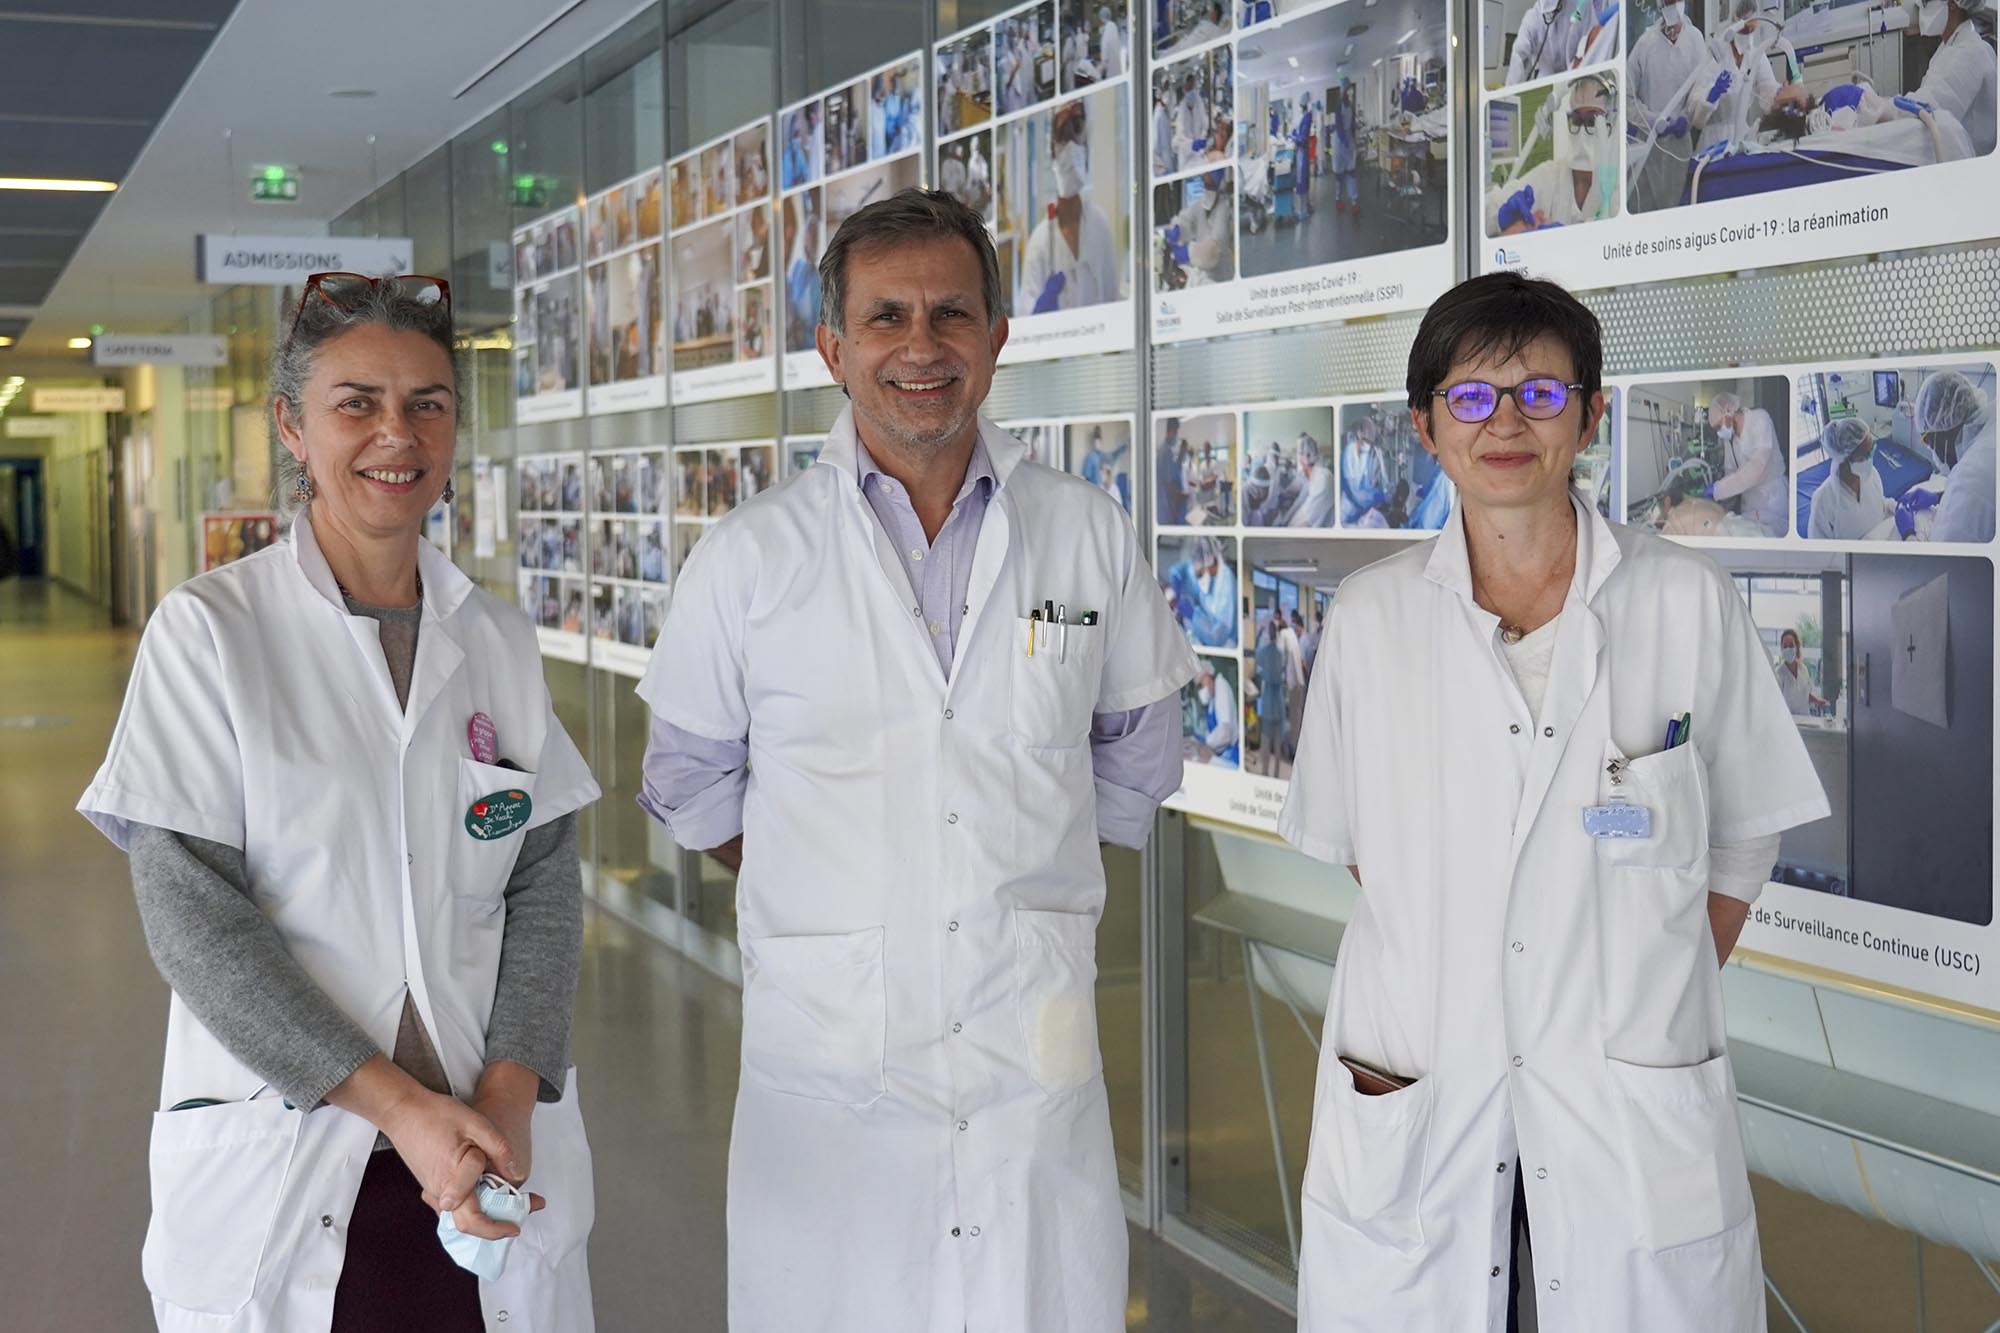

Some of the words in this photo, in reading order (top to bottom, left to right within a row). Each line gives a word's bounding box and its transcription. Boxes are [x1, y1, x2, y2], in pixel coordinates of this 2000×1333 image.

[1603, 241, 1632, 261] Unité
[1634, 240, 1649, 256] de
[1651, 236, 1682, 254] soins
[1684, 231, 1717, 252] aigus
[1720, 219, 1778, 244] Covid-19
[1788, 216, 1800, 234] la
[1803, 205, 1889, 232] réanimation
[224, 251, 344, 270] ADMISSIONS
[1270, 285, 1279, 298] de
[1280, 283, 1300, 297] soins
[1300, 279, 1320, 296] aigus
[1321, 272, 1357, 290] Covid-19
[1234, 309, 1243, 322] de
[1243, 303, 1287, 321] Surveillance
[1755, 907, 1771, 925] de
[1774, 910, 1859, 946] Surveillance
[1862, 930, 1929, 962] Continue
[1934, 945, 1980, 976] (USC)
